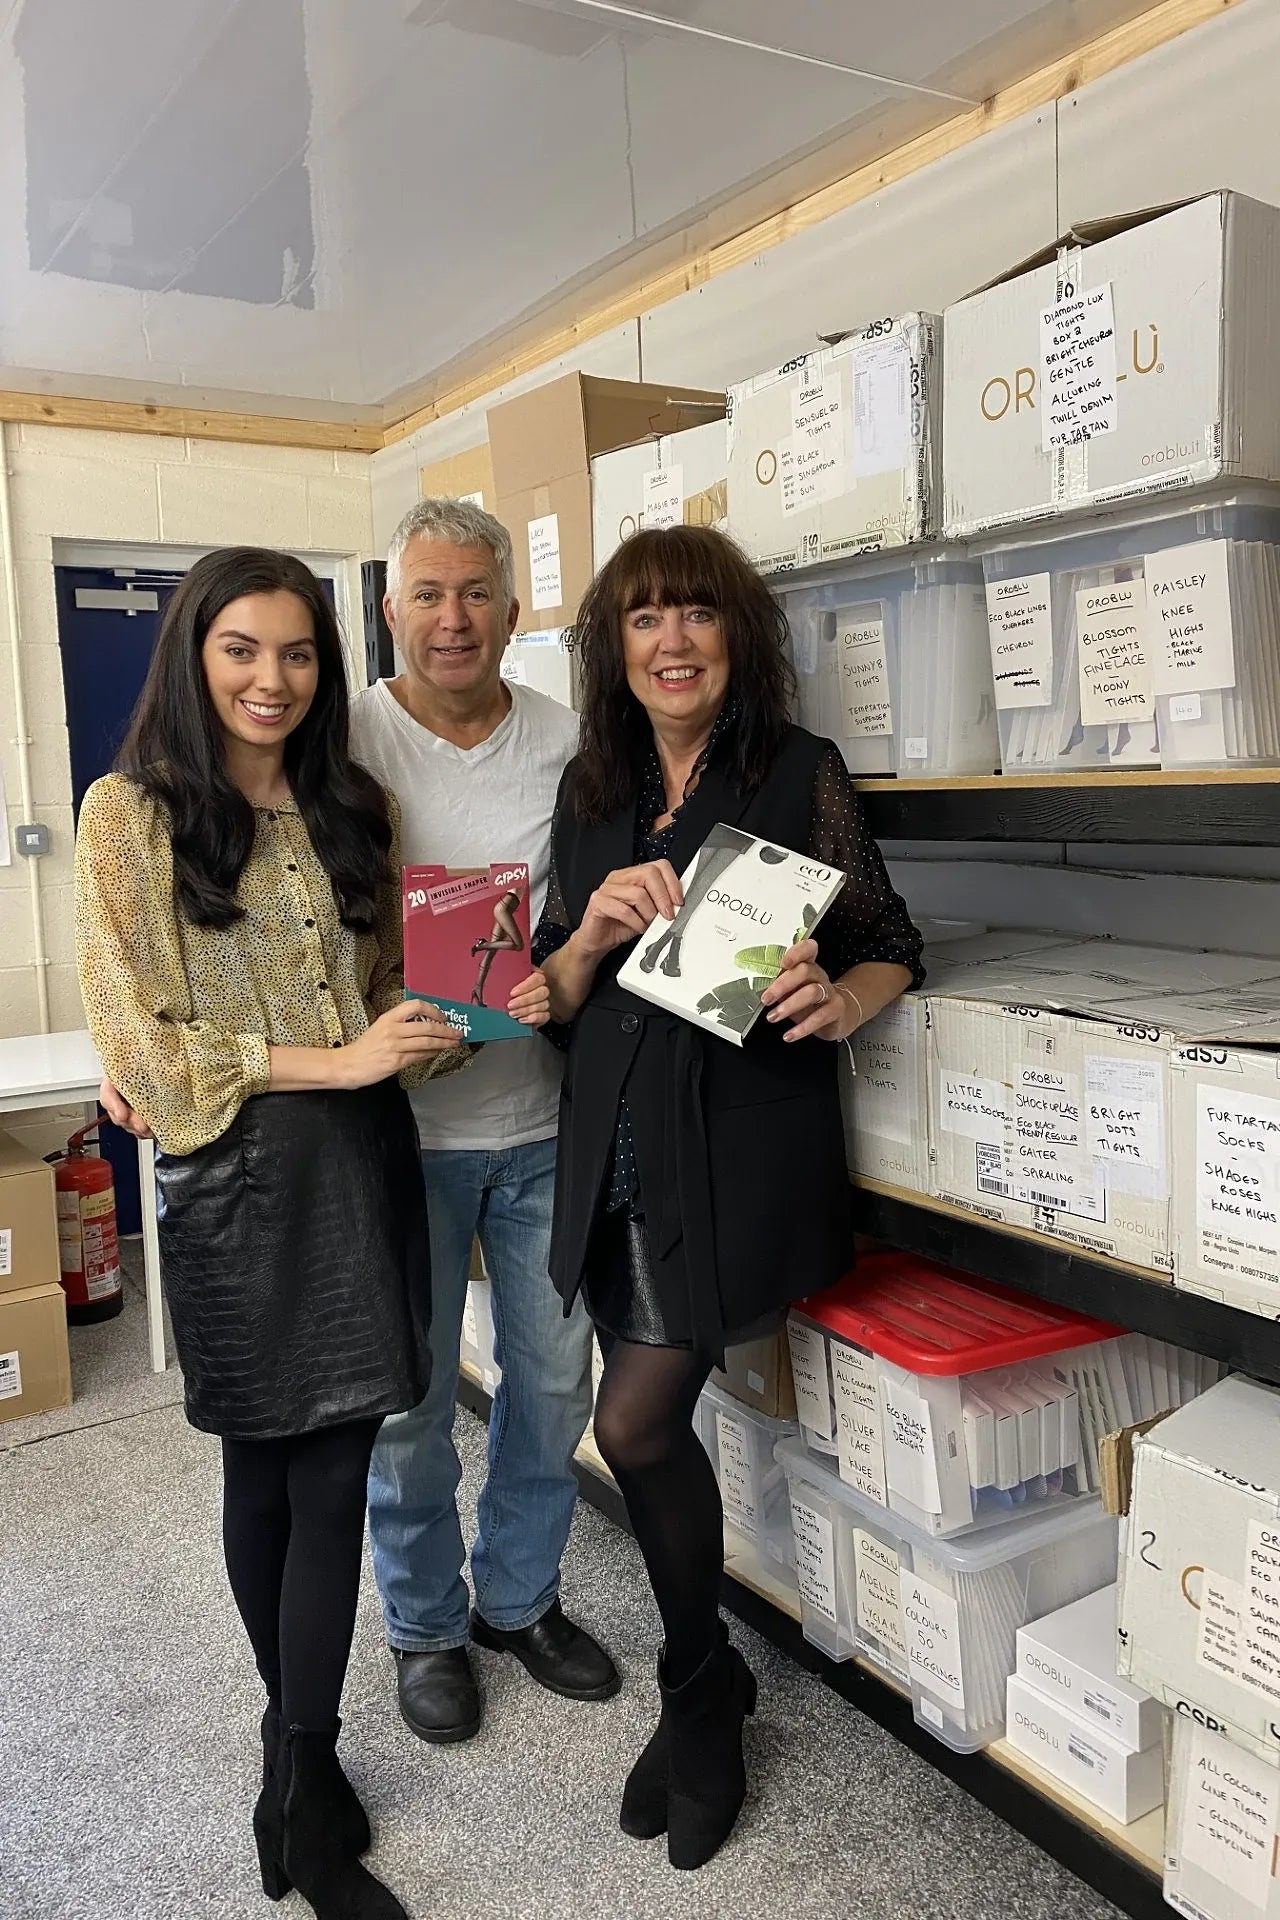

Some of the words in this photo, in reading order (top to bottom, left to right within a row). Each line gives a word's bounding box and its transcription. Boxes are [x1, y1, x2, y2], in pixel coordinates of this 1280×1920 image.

[1044, 301, 1085, 325] DIAMOND
[1087, 292, 1105, 306] LUX
[1055, 312, 1086, 330] TIGHTS
[1053, 332, 1071, 346] BOX
[1074, 326, 1082, 336] 2
[1045, 346, 1077, 366] BRIGHT
[1049, 355, 1095, 383] GENTLE
[800, 385, 823, 401] OROBLU
[1051, 377, 1103, 406] ALLURING
[795, 407, 828, 429] SENSUEL
[1050, 409, 1078, 426] TWILL
[1081, 393, 1114, 415] DENIM
[806, 421, 832, 438] TIGHTS
[1050, 433, 1067, 447] FUR
[1070, 419, 1110, 439] TARTAN
[797, 449, 820, 465] BLACK
[1141, 440, 1201, 466] oroblu.it
[800, 484, 815, 496] SUN
[997, 581, 1029, 596] OROBLU
[1153, 573, 1208, 597] PAISLEY
[1087, 590, 1133, 609] OROBLU
[989, 612, 1003, 623] ECO
[1004, 608, 1026, 621] BLACK
[1027, 603, 1047, 615] LINES
[1161, 604, 1195, 621] KNEE
[1002, 617, 1035, 631] SNEAKERS
[1169, 623, 1204, 639] HIGHS
[844, 628, 880, 645] OROBLU
[997, 640, 1034, 655] CHEVRON
[1097, 641, 1140, 659] TIGHTS
[844, 660, 876, 677] SUNNY
[854, 675, 880, 688] TIGHTS
[1093, 680, 1130, 695] MOONY
[1105, 694, 1146, 707] TIGHTS
[495, 866, 527, 886] GIPSY
[431, 884, 462, 901] INVISIBLE
[464, 876, 489, 889] SHAPER
[408, 889, 427, 908] 20
[860, 1040, 904, 1055] SENSUEL
[870, 1058, 892, 1070] LACE
[864, 1076, 897, 1091] TIGHTS
[1023, 1070, 1063, 1085] OROBLU
[947, 1082, 983, 1099] LITTLE
[948, 1100, 978, 1113] ROSES
[980, 1105, 1006, 1119] SOCKS
[1090, 1105, 1141, 1121] BRIGHT
[1207, 1107, 1231, 1122] FUR
[1035, 1120, 1056, 1130] BLACK
[1106, 1124, 1136, 1137] DOTS
[1097, 1138, 1141, 1157] TIGHTS
[1217, 1131, 1266, 1152] SOCKS
[1019, 1145, 1058, 1161] GAITER
[1022, 1166, 1074, 1184] SPIRALING
[1204, 1162, 1260, 1187] SHADED
[1220, 1184, 1262, 1202] ROSES
[1211, 1198, 1241, 1216] KNEE
[1246, 1207, 1277, 1223] HIGHS
[1203, 1254, 1234, 1270] Consegna
[836, 1369, 850, 1382] ALL
[840, 1412, 875, 1439] SILVER
[886, 1403, 901, 1419] ECO
[902, 1413, 927, 1435] BLACK
[850, 1436, 871, 1454] LACE
[893, 1430, 925, 1455] DELIGHT
[849, 1456, 873, 1478] KNEE
[856, 1477, 882, 1501] HIGHS
[861, 1539, 898, 1571] OROBLU
[859, 1568, 897, 1600] ADELLE
[912, 1589, 931, 1609] ALL
[905, 1606, 948, 1640] COLOURS
[917, 1631, 934, 1649] 50
[910, 1646, 960, 1687] LEGGINGS
[1025, 1652, 1072, 1689] OROBLU
[1014, 1711, 1060, 1750] OROBLU
[1198, 1757, 1220, 1776] ALL
[1223, 1772, 1269, 1805] COLOURS
[1201, 1780, 1228, 1801] LINE
[1232, 1797, 1268, 1826] TIGHTS
[1209, 1827, 1254, 1860] SKYLINE
